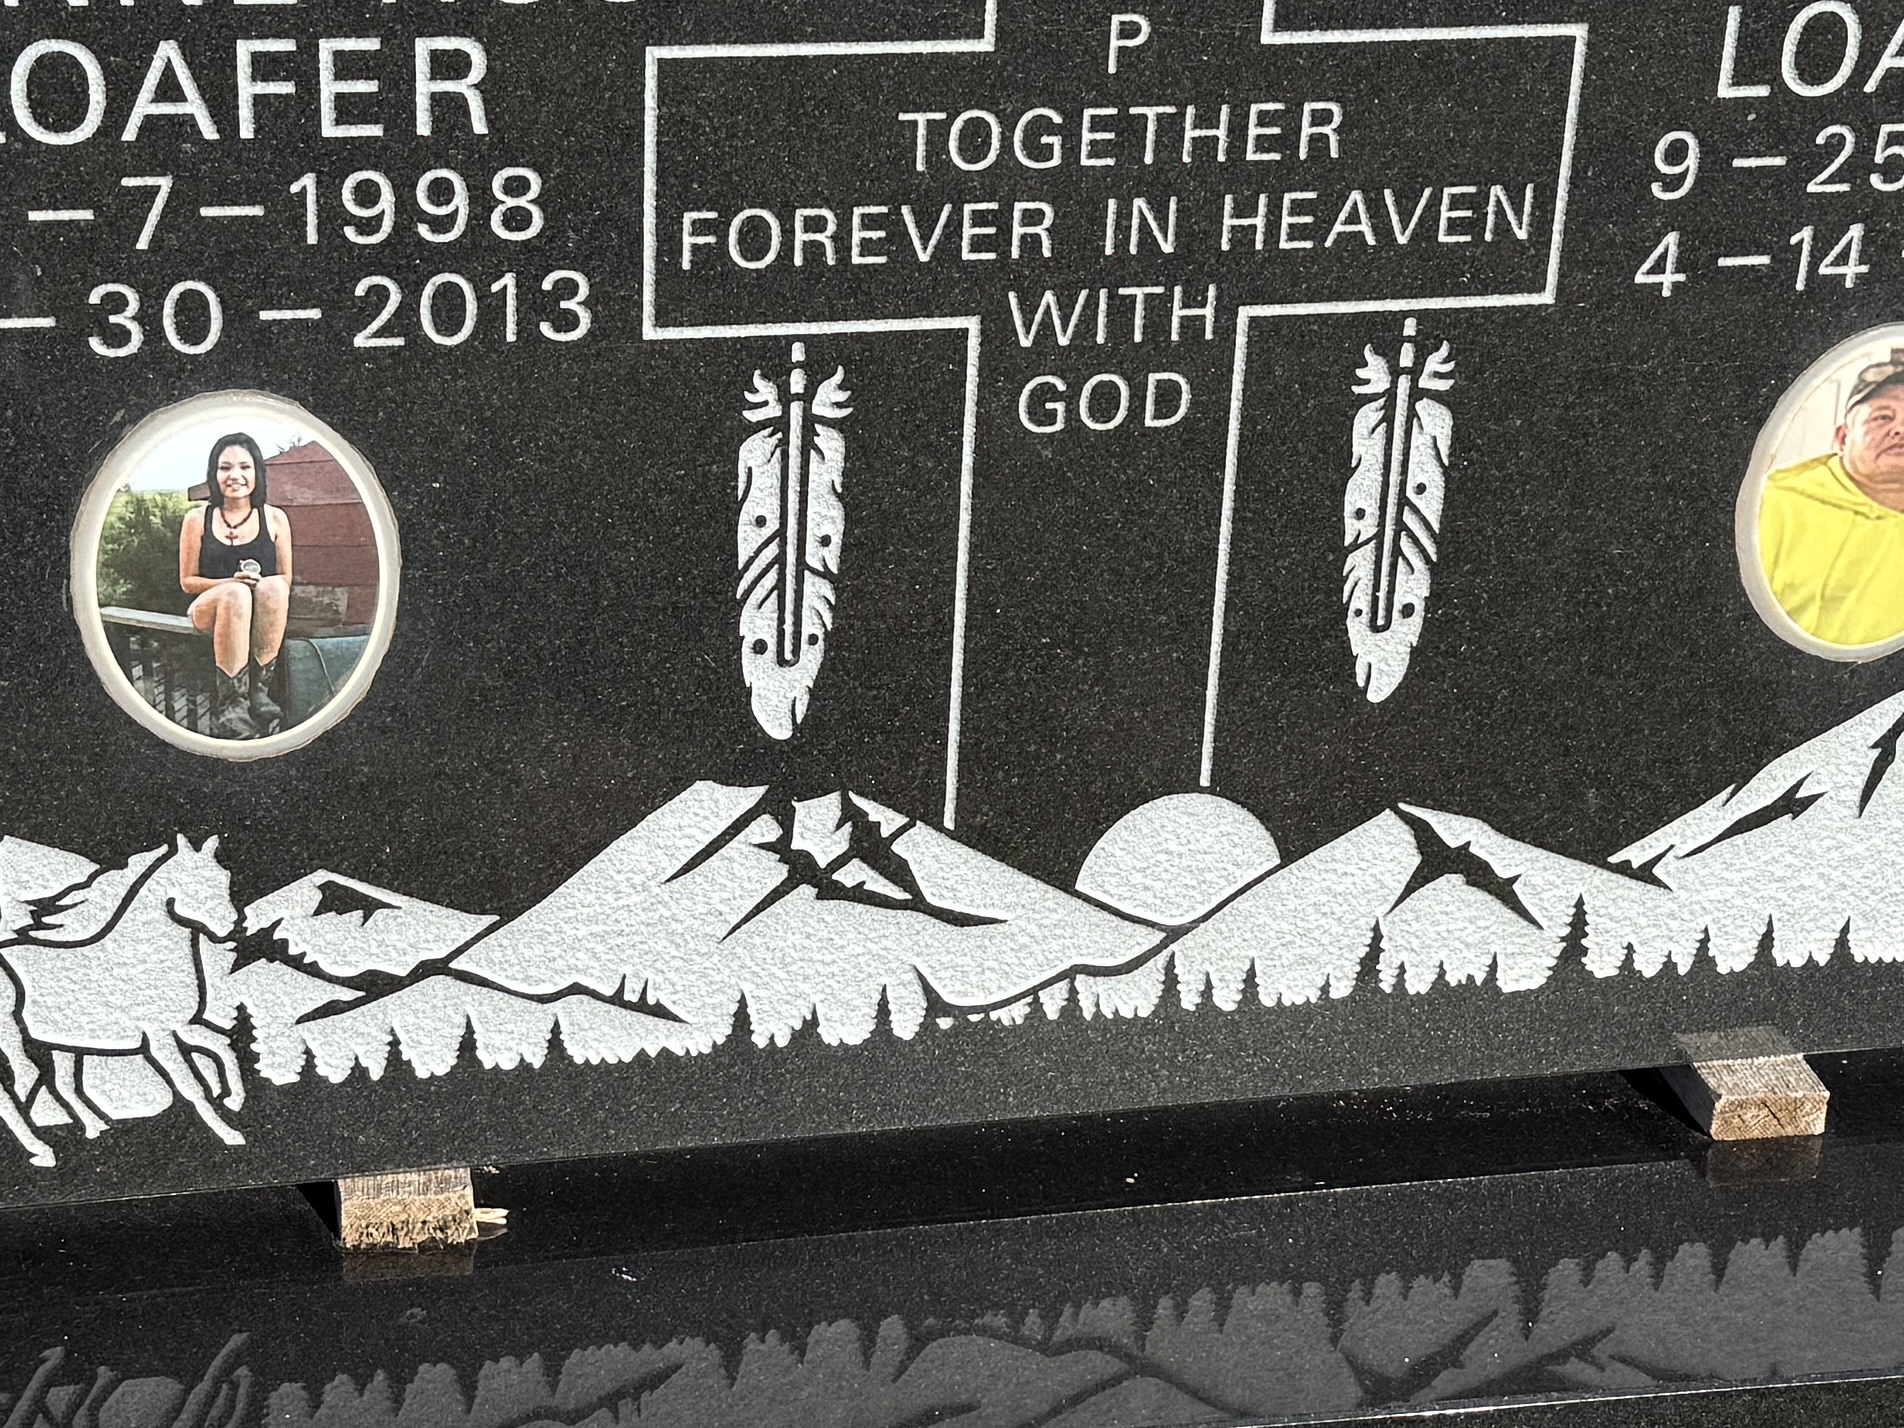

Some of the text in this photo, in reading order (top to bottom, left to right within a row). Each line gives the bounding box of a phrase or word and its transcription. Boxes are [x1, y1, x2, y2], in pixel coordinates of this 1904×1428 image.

[898, 102, 1342, 172] TOGETHER
[682, 184, 1534, 270] FOREVER IN HEAVEN
[1008, 284, 1216, 347] WITH
[1019, 372, 1191, 433] GOD
